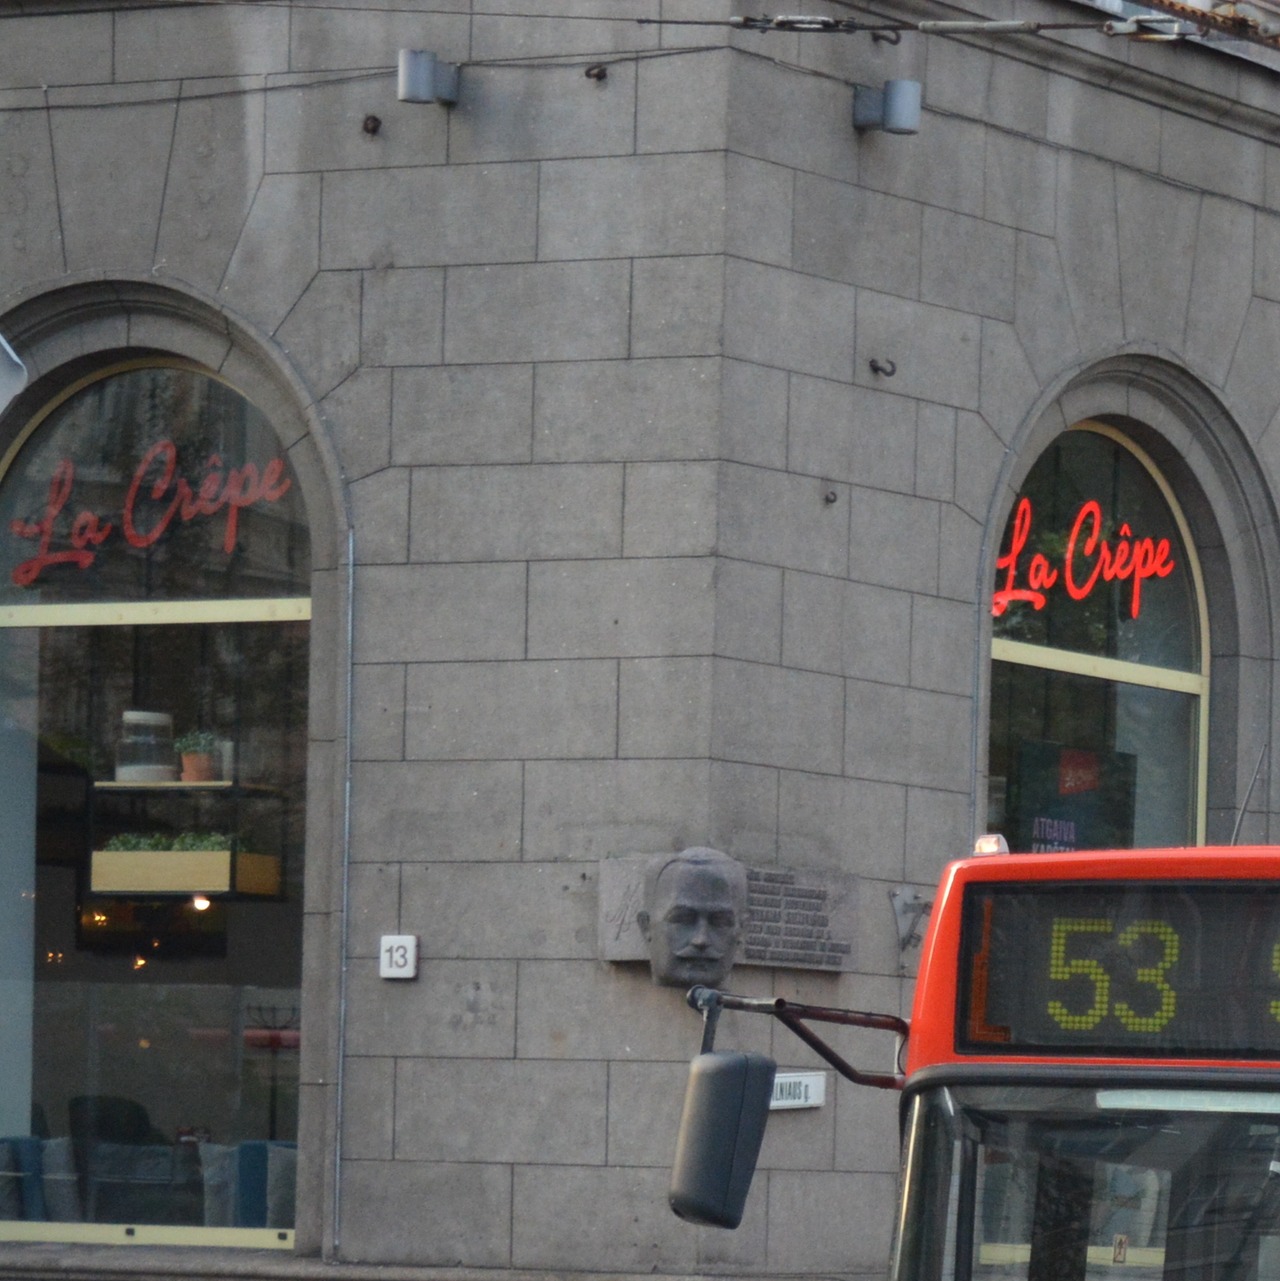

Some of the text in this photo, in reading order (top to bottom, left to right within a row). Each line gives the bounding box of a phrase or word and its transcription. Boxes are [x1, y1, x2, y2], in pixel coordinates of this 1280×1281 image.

[10, 439, 292, 586] La Crêpe
[991, 497, 1175, 619] La Crêpe
[385, 945, 408, 969] 13
[1047, 917, 1181, 1033] 53
